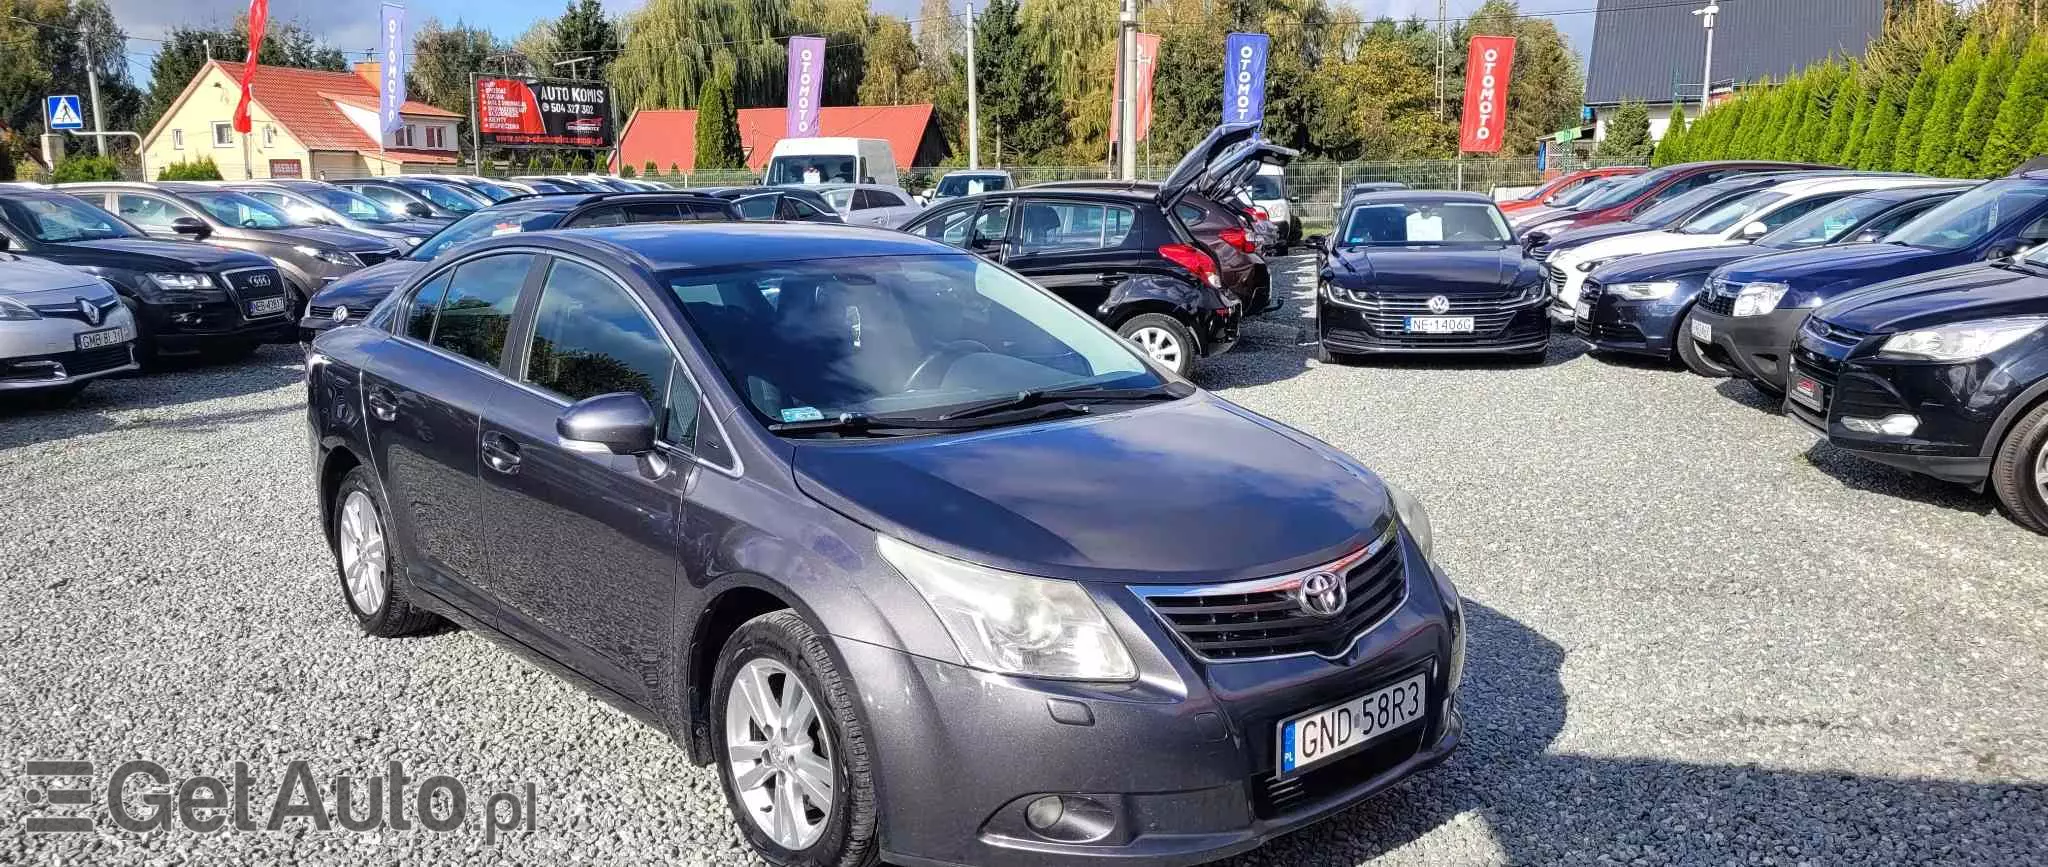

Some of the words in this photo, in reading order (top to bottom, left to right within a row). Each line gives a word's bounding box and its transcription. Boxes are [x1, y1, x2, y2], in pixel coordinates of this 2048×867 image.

[388, 18, 397, 122] OTOMOTO
[541, 86, 569, 102] AUTO
[571, 87, 604, 103] KOMIS
[799, 49, 812, 133] OTOMOTO
[1237, 45, 1253, 120] OTOMOT
[1477, 48, 1498, 140] OTOMOTO
[551, 103, 566, 113] 504
[1413, 319, 1429, 331] NE
[1284, 752, 1294, 762] PL
[1302, 707, 1352, 758] GND
[1361, 681, 1419, 735] 58R3
